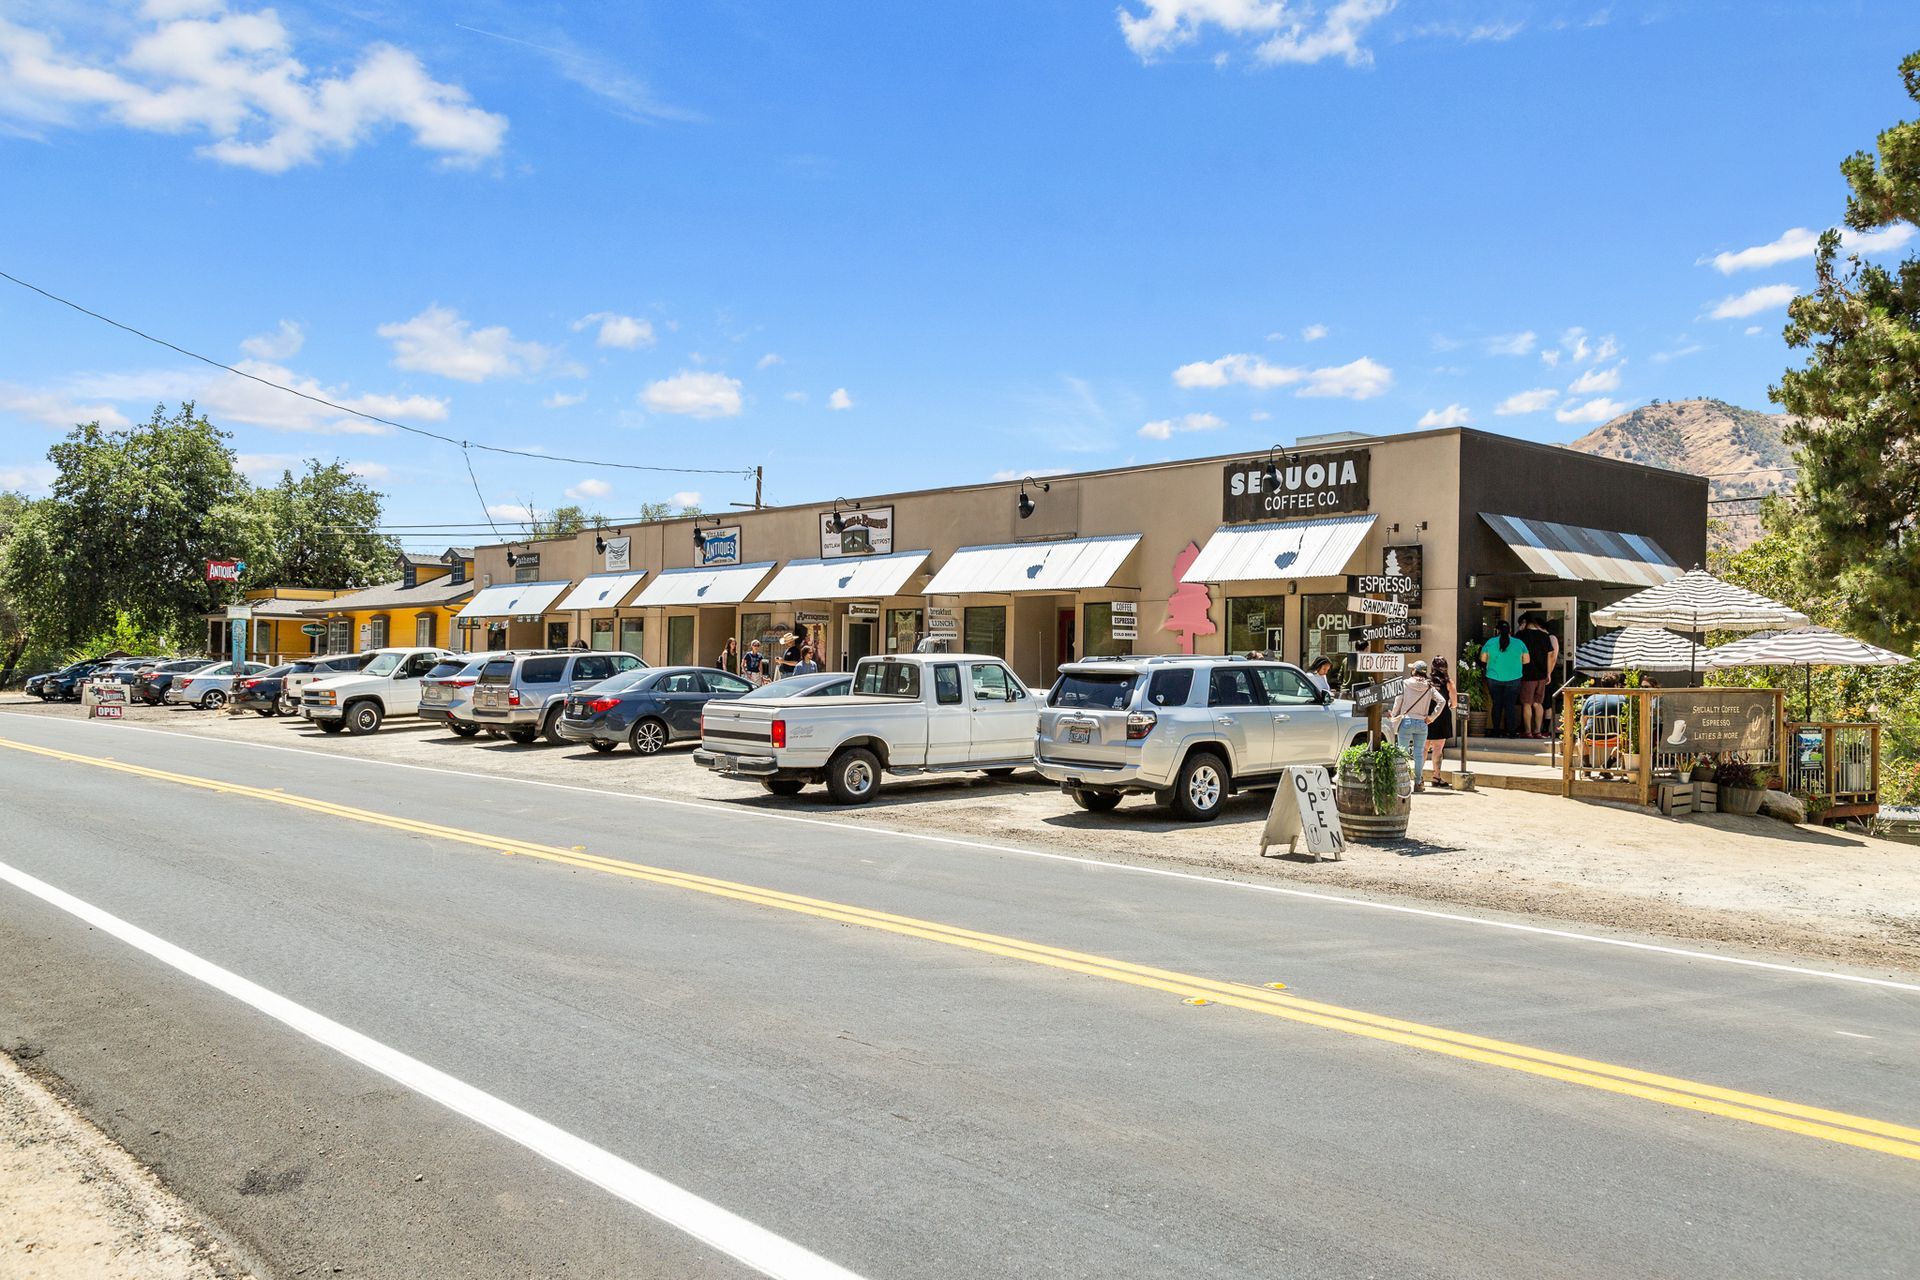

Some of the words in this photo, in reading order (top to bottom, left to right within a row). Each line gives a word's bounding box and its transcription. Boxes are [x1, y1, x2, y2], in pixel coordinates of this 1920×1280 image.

[1265, 492, 1315, 511] COFFEE
[1318, 490, 1339, 506] CO.
[705, 541, 735, 560] ANTIQUES
[1358, 576, 1412, 594] ESPRESSO
[1116, 602, 1133, 612] COFFEE
[1362, 599, 1408, 618] SANDWICHES
[1114, 617, 1136, 625] ESPRESSO
[1317, 613, 1352, 631] OPEN
[1363, 623, 1406, 641] Smoothies
[1360, 655, 1374, 670] ICED
[1375, 655, 1399, 670] COFFEE
[98, 706, 121, 716] OPEN
[1721, 705, 1740, 714] COFFEE
[1702, 718, 1731, 727] ESPRESSO
[1694, 731, 1717, 740] LATTES
[1295, 774, 1343, 848] OPEN
